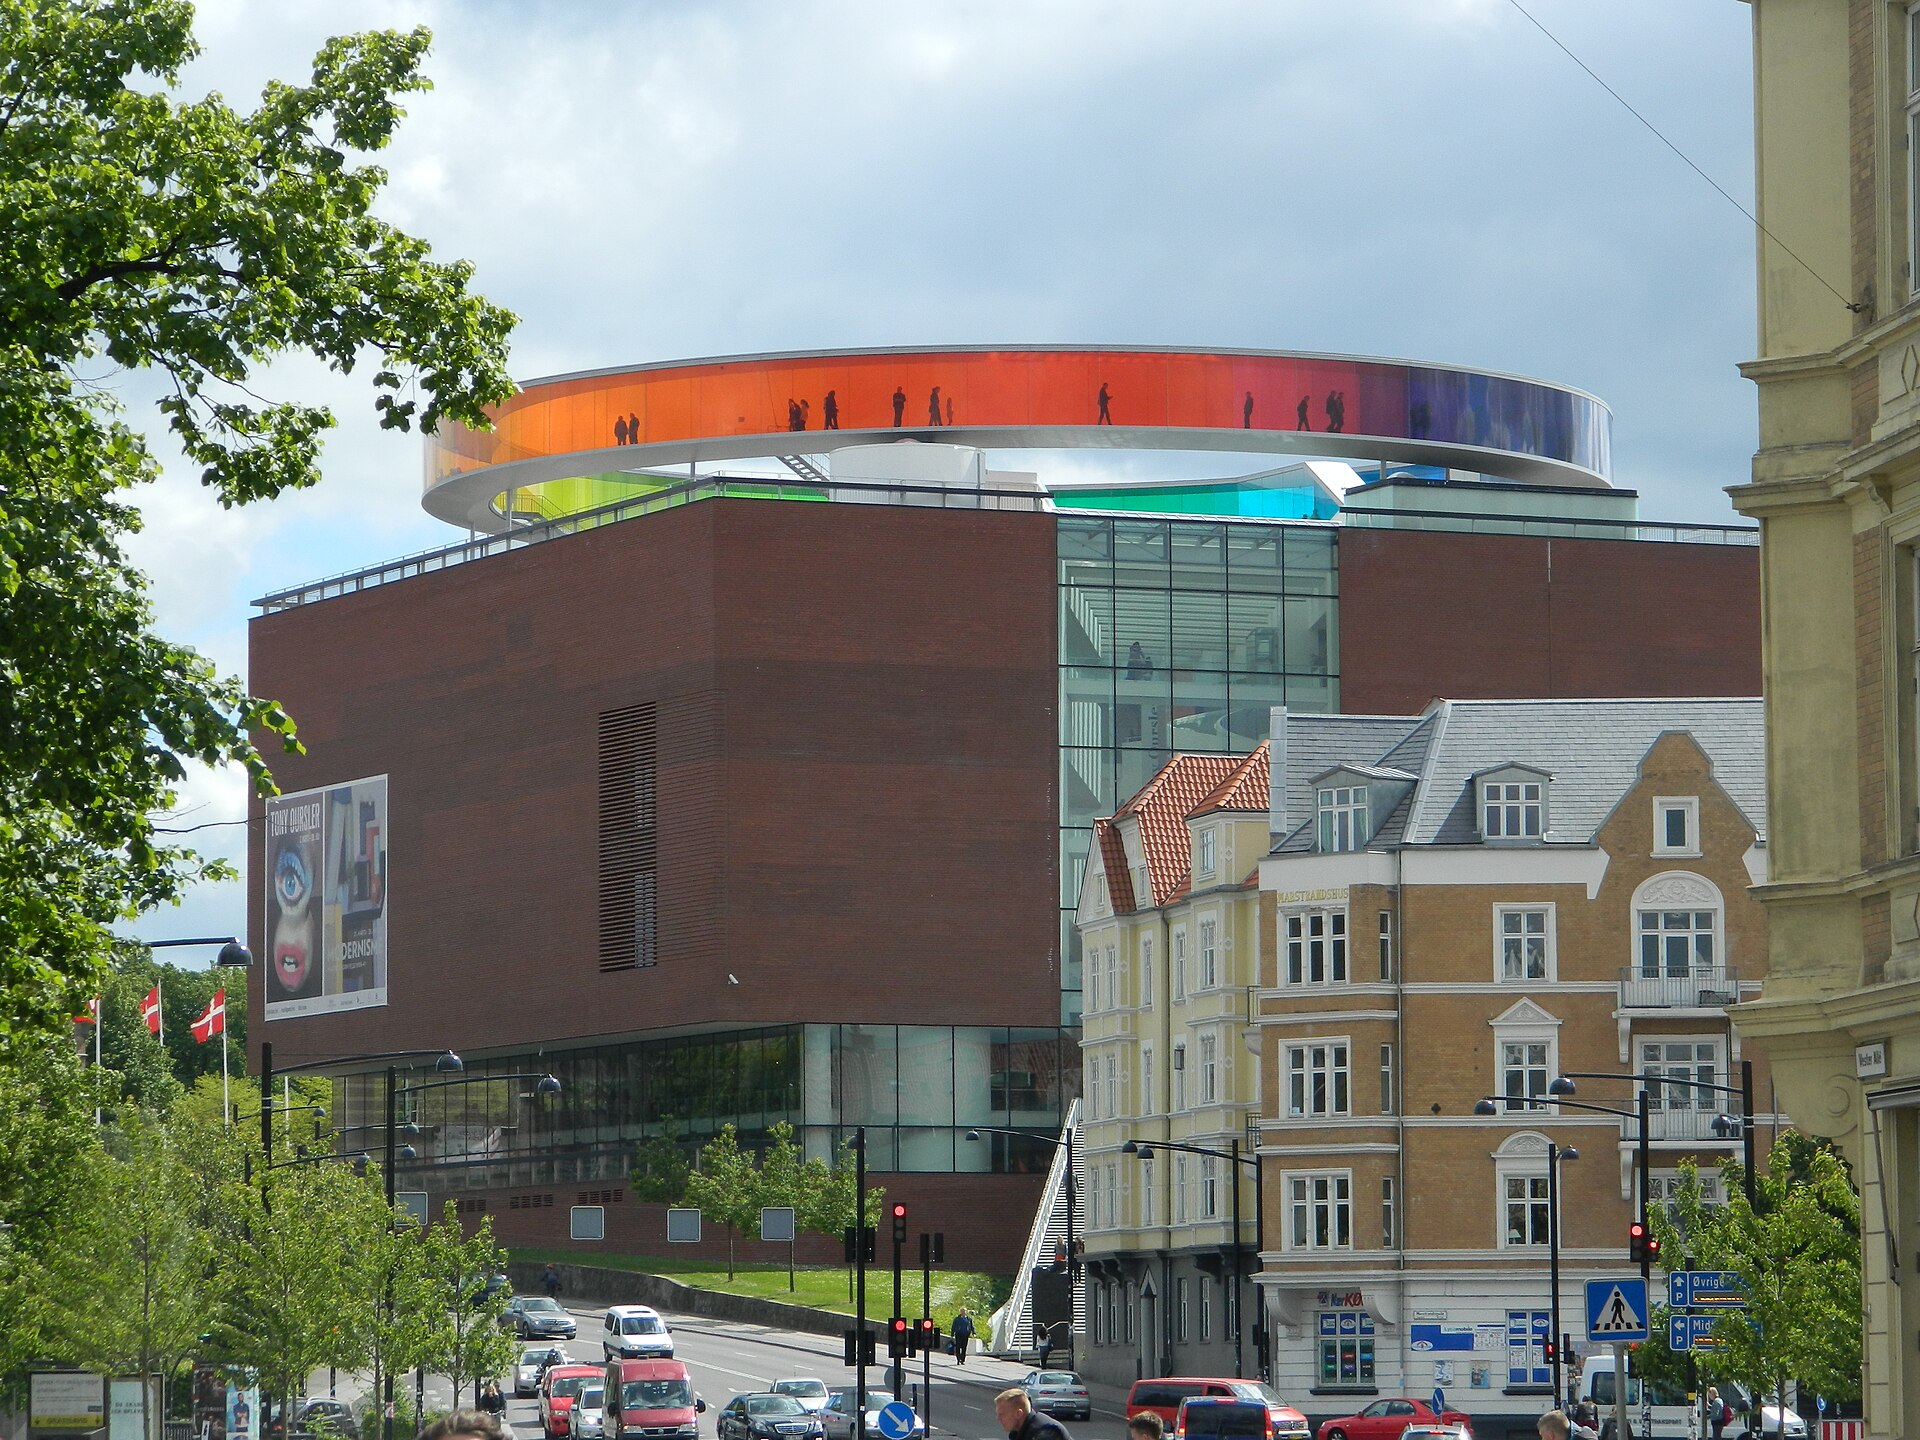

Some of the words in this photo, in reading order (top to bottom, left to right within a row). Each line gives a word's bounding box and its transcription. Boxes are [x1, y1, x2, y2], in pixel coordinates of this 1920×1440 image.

[270, 808, 289, 837] TONY
[290, 803, 320, 834] OURSLER
[1693, 1276, 1725, 1289] Øvrige
[1676, 1292, 1683, 1301] P
[1676, 1336, 1683, 1345] P
